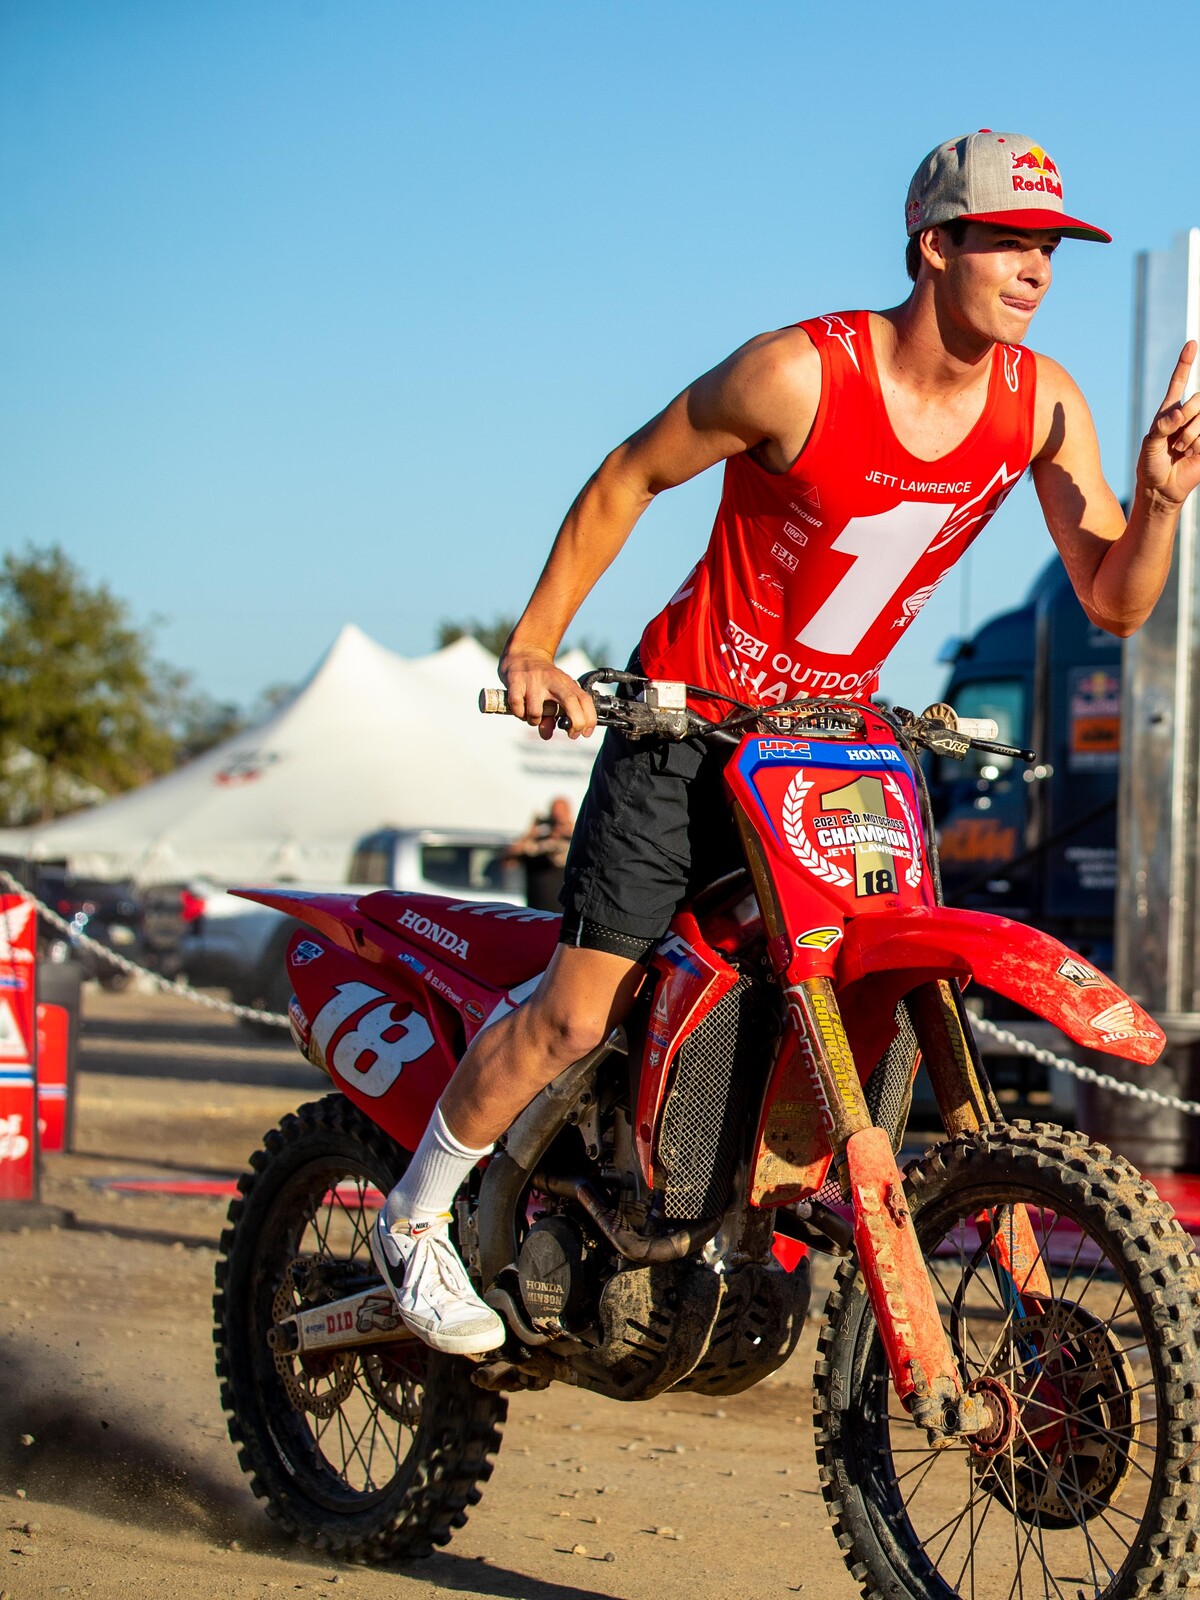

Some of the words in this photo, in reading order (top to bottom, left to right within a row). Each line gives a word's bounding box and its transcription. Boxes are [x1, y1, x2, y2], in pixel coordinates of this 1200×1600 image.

[1012, 175, 1045, 191] Red
[865, 470, 898, 489] JETT
[900, 479, 972, 495] LAWRENCE
[789, 502, 823, 528] SHOWA
[787, 526, 805, 543] 100%
[795, 500, 956, 656] 1
[758, 741, 811, 759] HRC
[846, 750, 901, 761] HONDA
[932, 739, 971, 754] ARC
[814, 816, 838, 829] 2021
[841, 814, 860, 825] 250
[862, 813, 905, 830] MOTOCROSS
[817, 825, 910, 848] CHAMPION
[824, 846, 855, 858] JETT
[859, 844, 912, 859] LAWRENCE
[863, 869, 893, 896] 18
[397, 908, 470, 960] HONDA
[311, 981, 435, 1098] 18
[1100, 1030, 1161, 1044] HONDA
[526, 1280, 564, 1293] HONDA
[326, 1311, 353, 1334] DID
